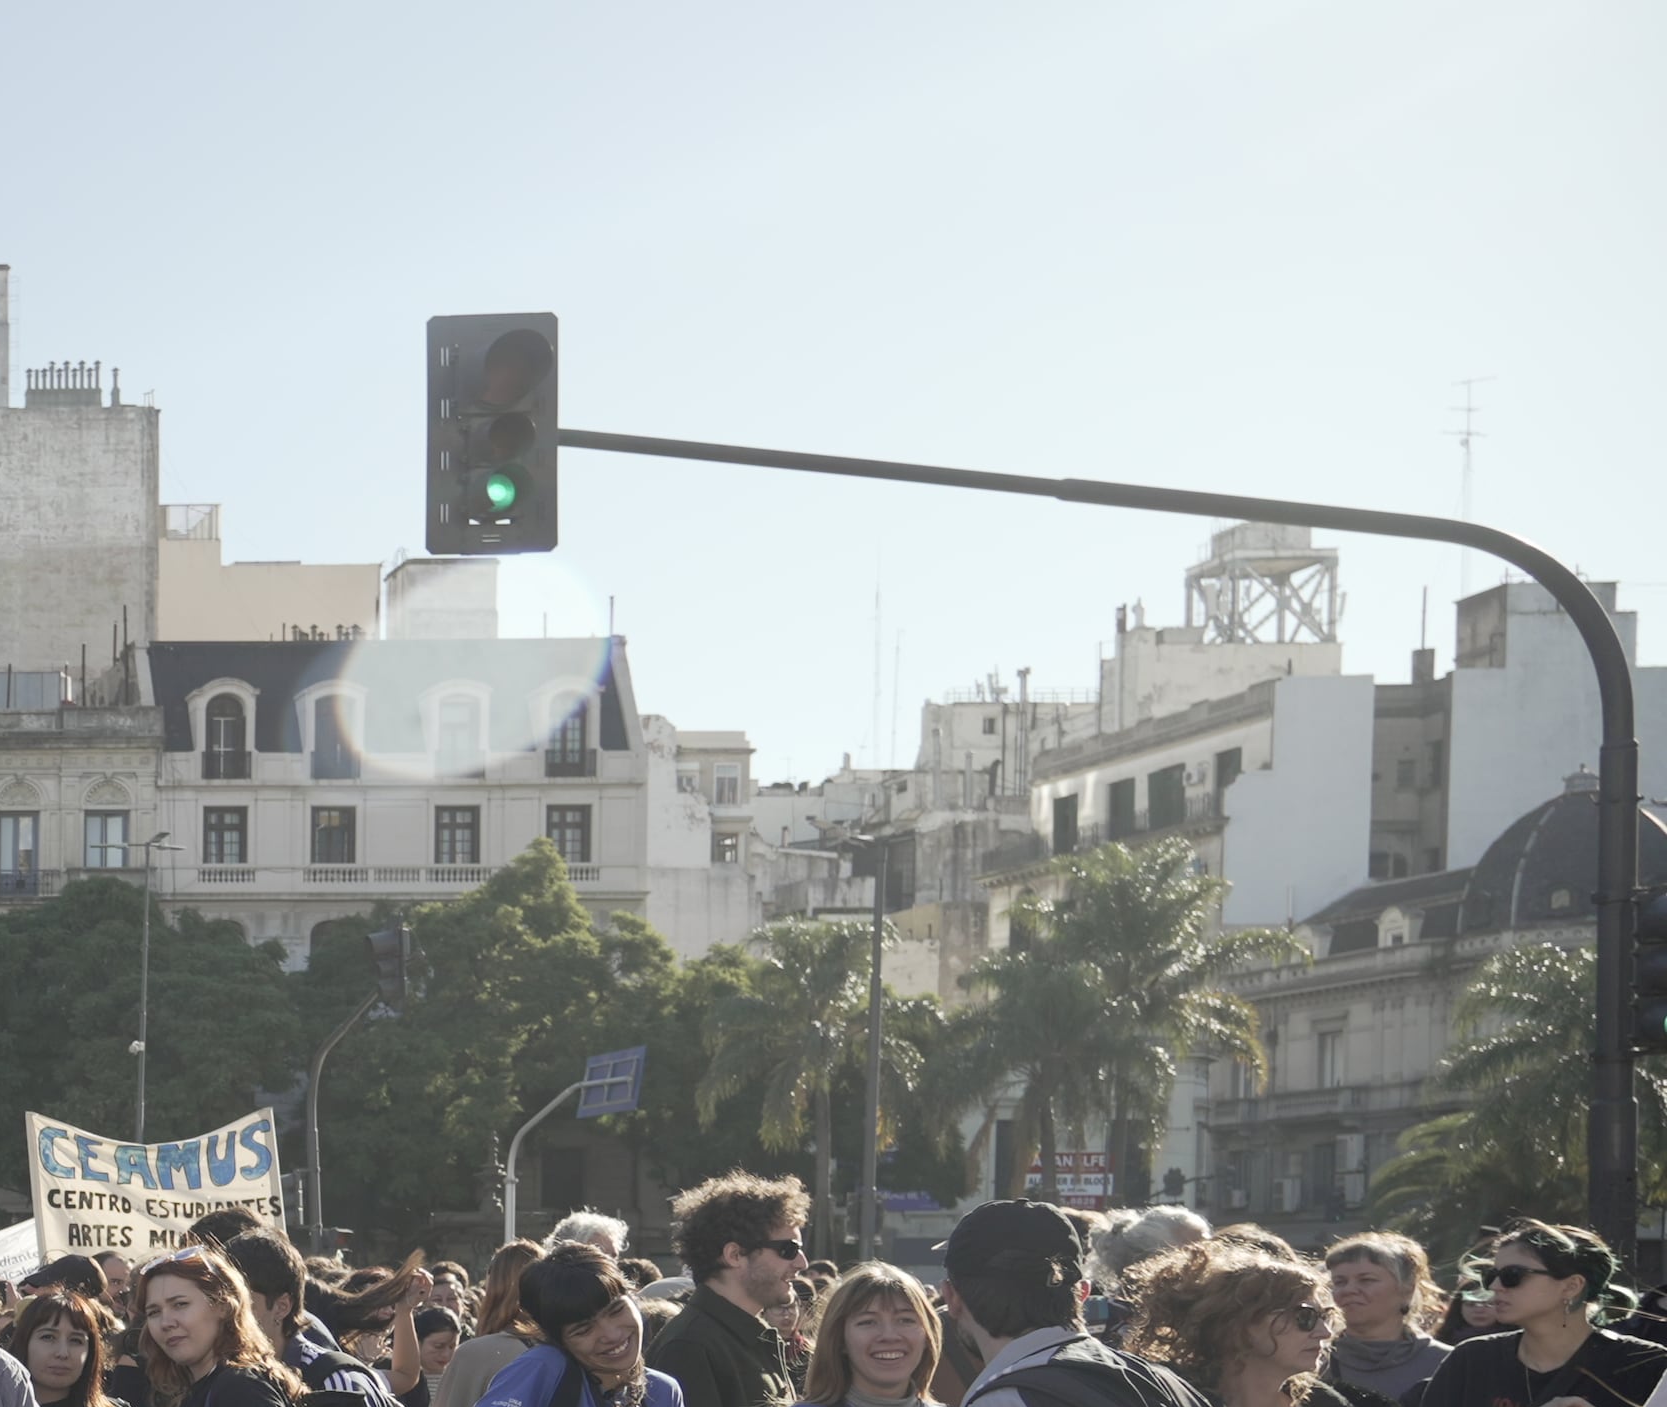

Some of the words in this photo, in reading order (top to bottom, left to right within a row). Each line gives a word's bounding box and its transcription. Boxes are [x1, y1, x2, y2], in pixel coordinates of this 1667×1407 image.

[38, 1119, 273, 1191] CEAMUS
[47, 1188, 131, 1214] CENTRO
[68, 1223, 133, 1248] ARTES
